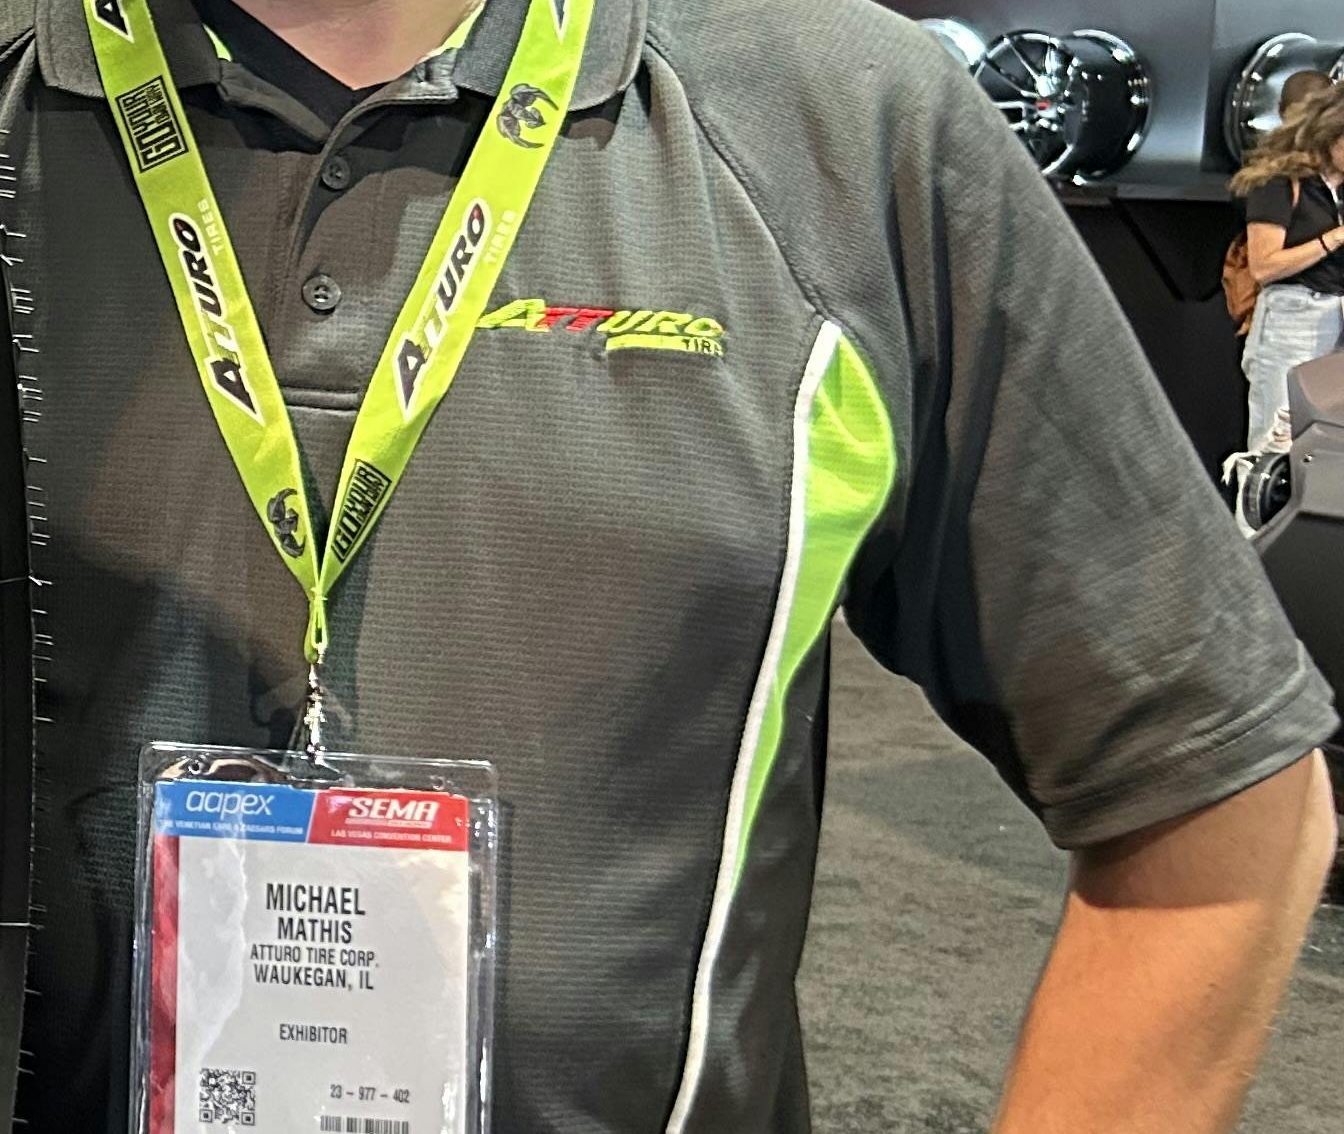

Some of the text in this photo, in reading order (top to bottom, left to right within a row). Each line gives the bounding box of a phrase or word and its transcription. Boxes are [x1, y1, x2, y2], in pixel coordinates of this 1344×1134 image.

[169, 215, 261, 419] ATTURO
[395, 200, 487, 416] ATTURO
[185, 789, 273, 817] aapex
[348, 796, 440, 822] SEMA
[266, 882, 366, 916] MICHAEL
[277, 917, 353, 944] MATHIS
[250, 943, 380, 968] ATTURO TIRE CORP.
[253, 963, 375, 992] WAUKEGAN, IL
[278, 1023, 349, 1045] EXHIBITOR
[330, 1083, 343, 1099] 23
[358, 1086, 377, 1101] 977
[393, 1088, 411, 1104] 402
